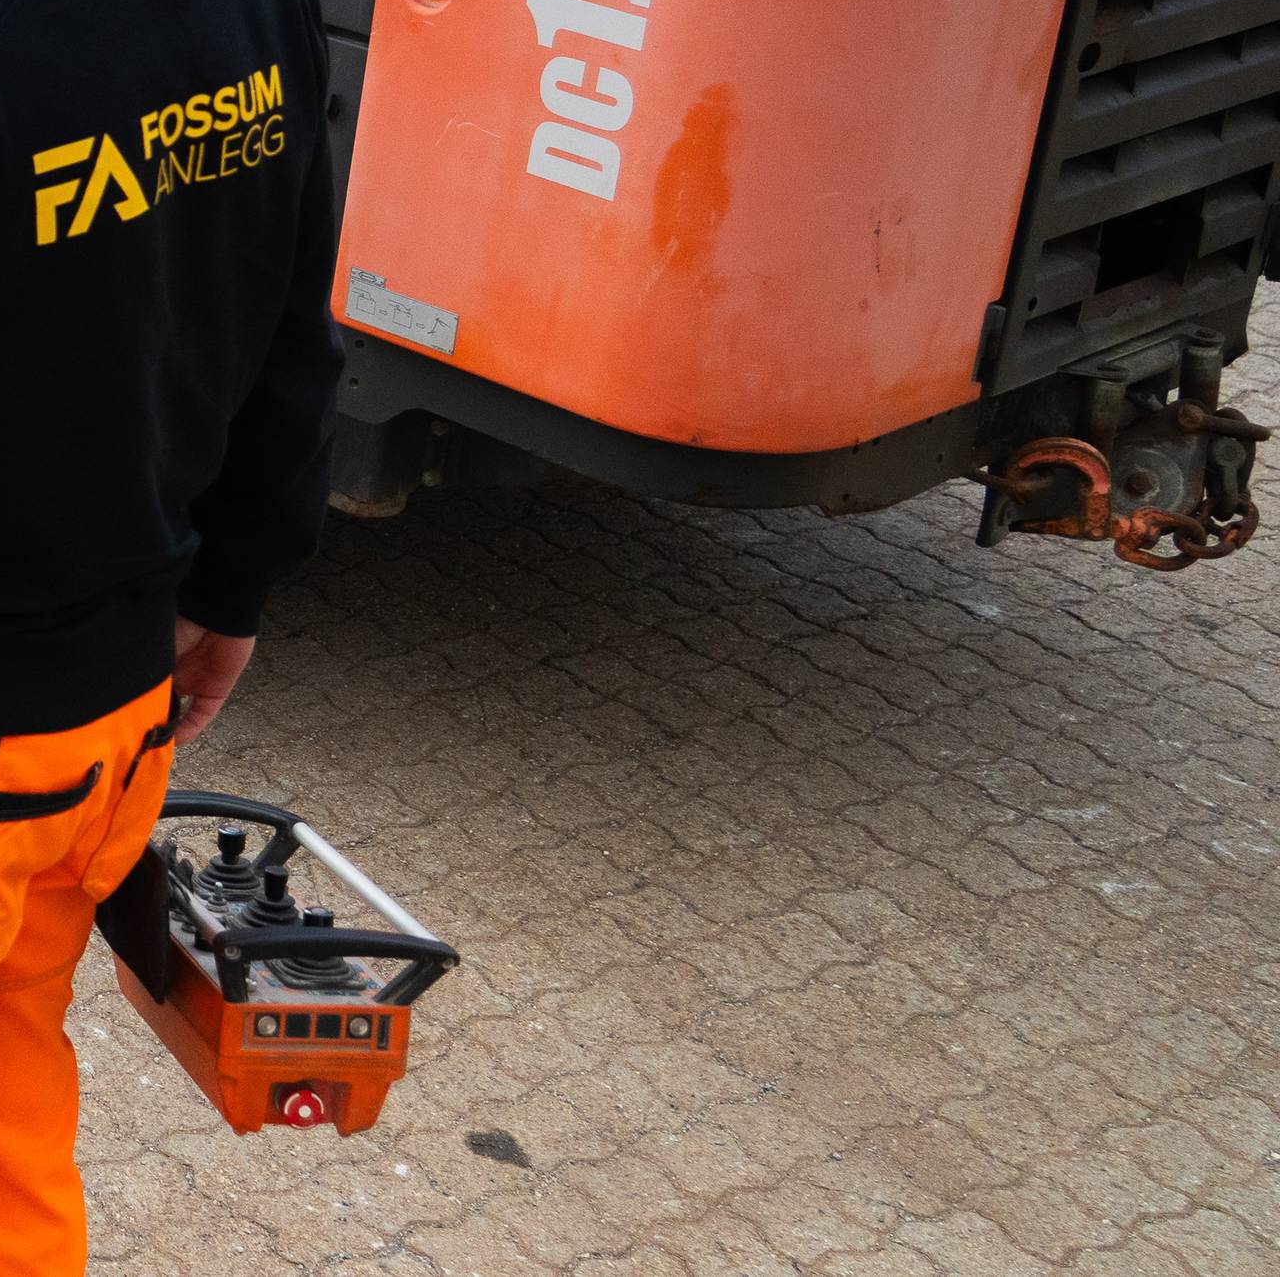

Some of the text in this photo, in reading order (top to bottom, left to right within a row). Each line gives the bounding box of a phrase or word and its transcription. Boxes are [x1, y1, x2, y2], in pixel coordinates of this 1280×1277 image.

[140, 64, 284, 161] FOSSUM
[154, 114, 286, 205] ANLEGG
[32, 132, 151, 246] FA
